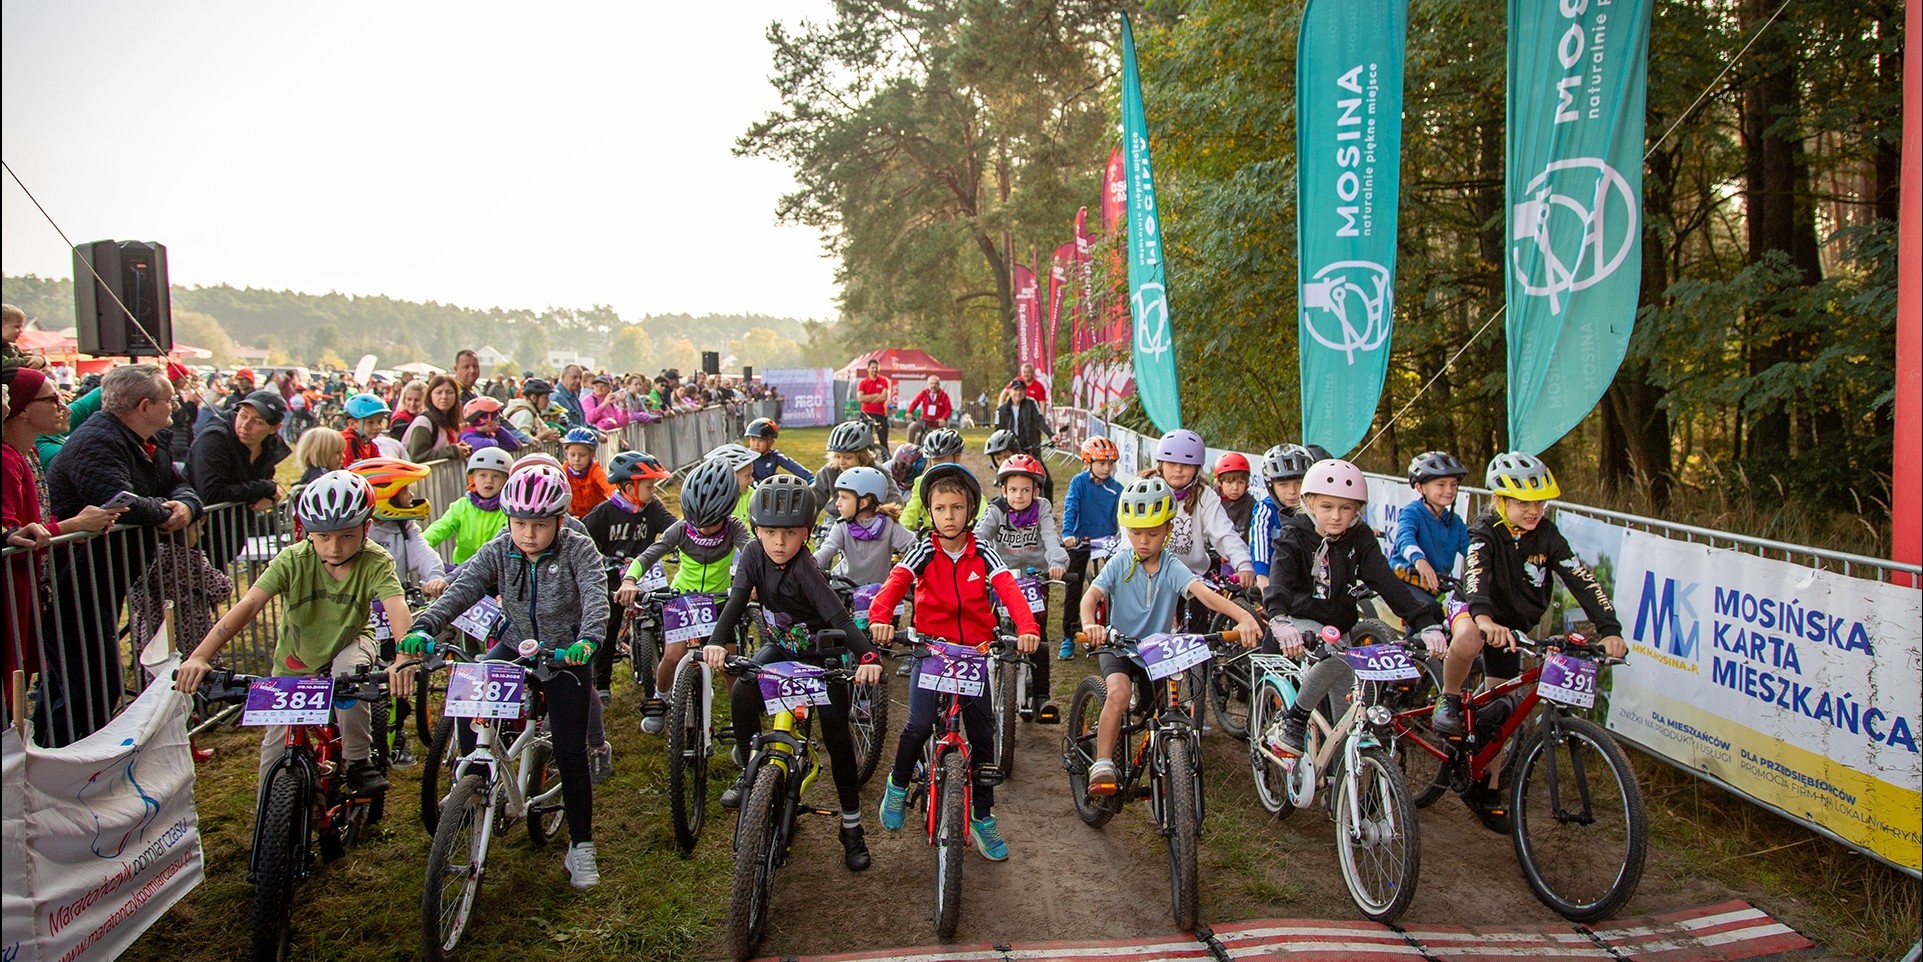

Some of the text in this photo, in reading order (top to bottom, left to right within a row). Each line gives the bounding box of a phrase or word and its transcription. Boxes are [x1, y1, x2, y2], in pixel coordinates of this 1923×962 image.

[1588, 13, 1607, 119] naturalnie
[1336, 64, 1364, 237] MOSINA
[1363, 63, 1379, 237] naturalnie piękne miejsce
[677, 606, 713, 628] 378
[1715, 585, 1875, 657] MOSIŃSKA
[1158, 634, 1201, 659] 322
[1367, 654, 1411, 671] 402
[1713, 620, 1802, 675] KARTA
[941, 659, 982, 681] 323
[1561, 670, 1593, 693] 391
[271, 691, 325, 710] 384
[469, 681, 518, 702] 387
[1712, 656, 1919, 754] MIESZKAŃCA
[1652, 711, 1731, 751] DLA MIESZKAŃCÓW
[1740, 749, 1758, 763] DLA
[1740, 760, 1789, 789] PROMOCJA
[1791, 784, 1816, 800] FIRM
[49, 861, 132, 937] Maratończyk
